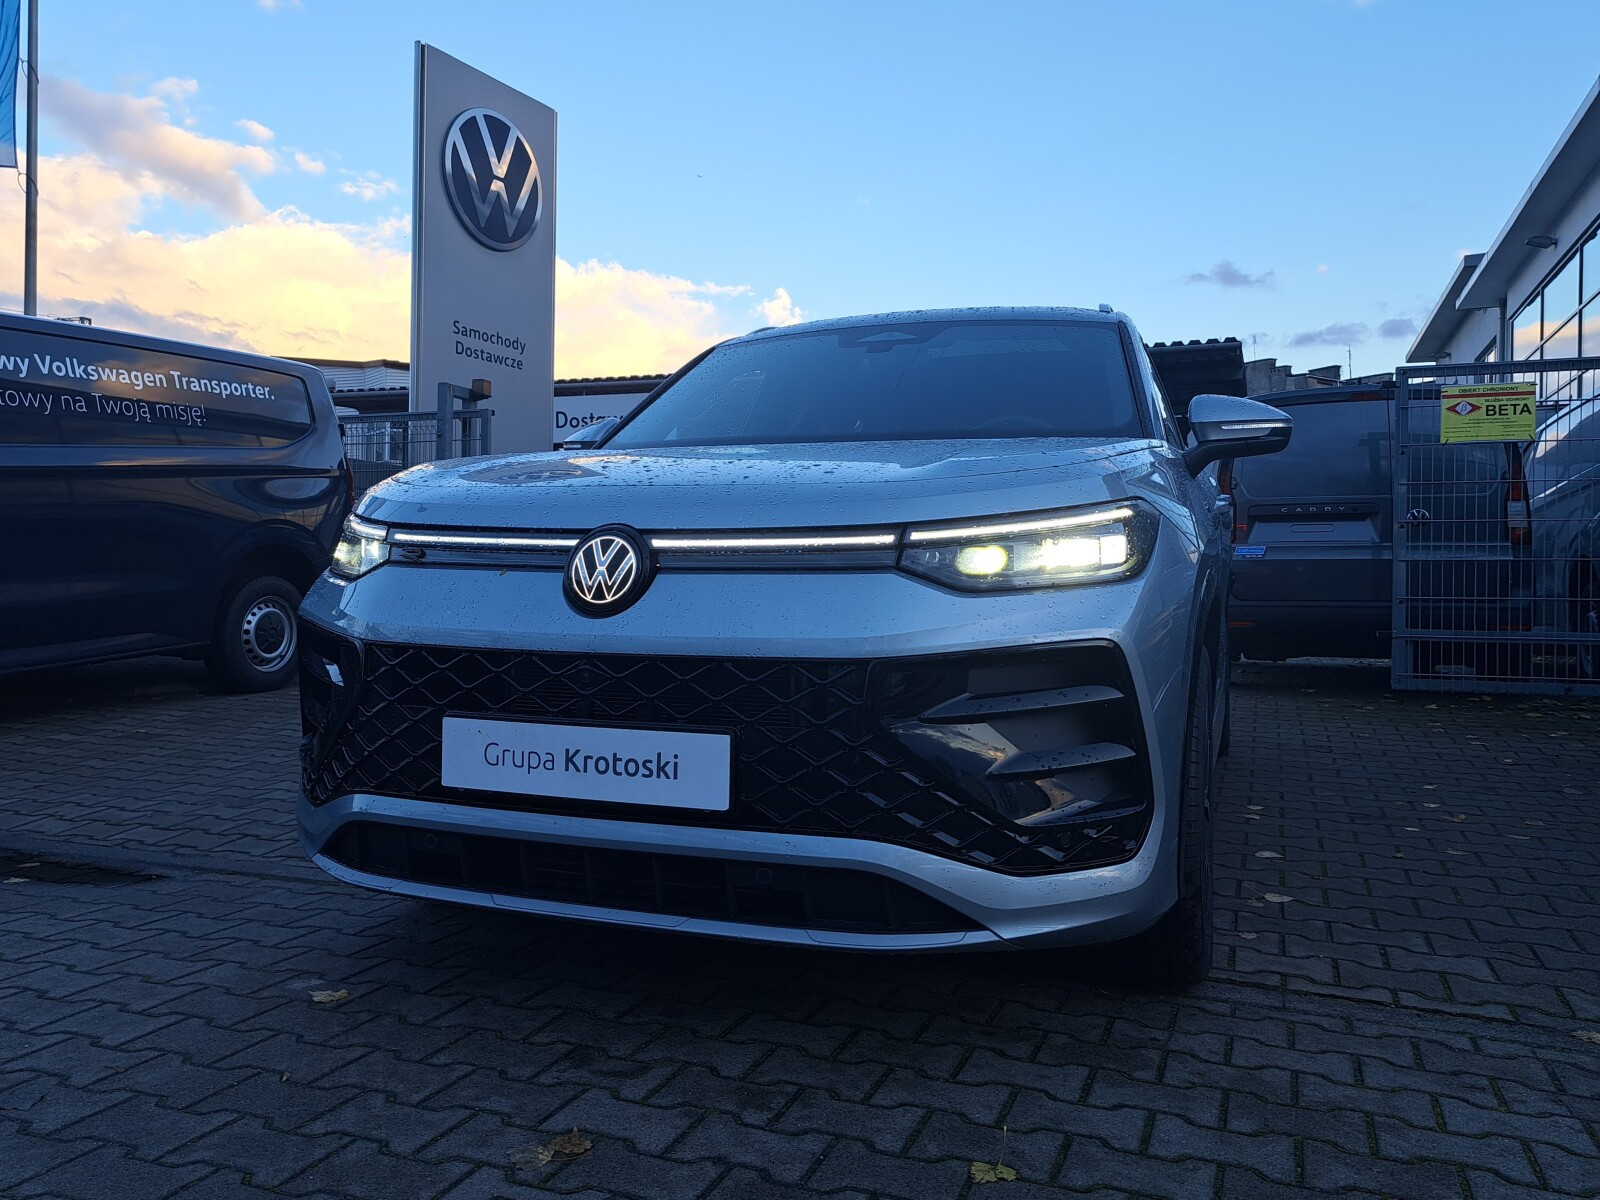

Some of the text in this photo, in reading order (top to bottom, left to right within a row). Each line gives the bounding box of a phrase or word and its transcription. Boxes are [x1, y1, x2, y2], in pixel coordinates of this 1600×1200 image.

[452, 320, 527, 354] Samochody
[455, 340, 524, 371] Dostawcze
[32, 353, 168, 390] Volkswagen
[169, 370, 276, 400] Transporter.
[60, 395, 88, 413] na
[90, 392, 152, 423] Twoją
[155, 402, 208, 427] misję!
[555, 411, 624, 429] Dost
[1485, 403, 1532, 416] BETA
[484, 743, 679, 780] Grupa Krotoski
